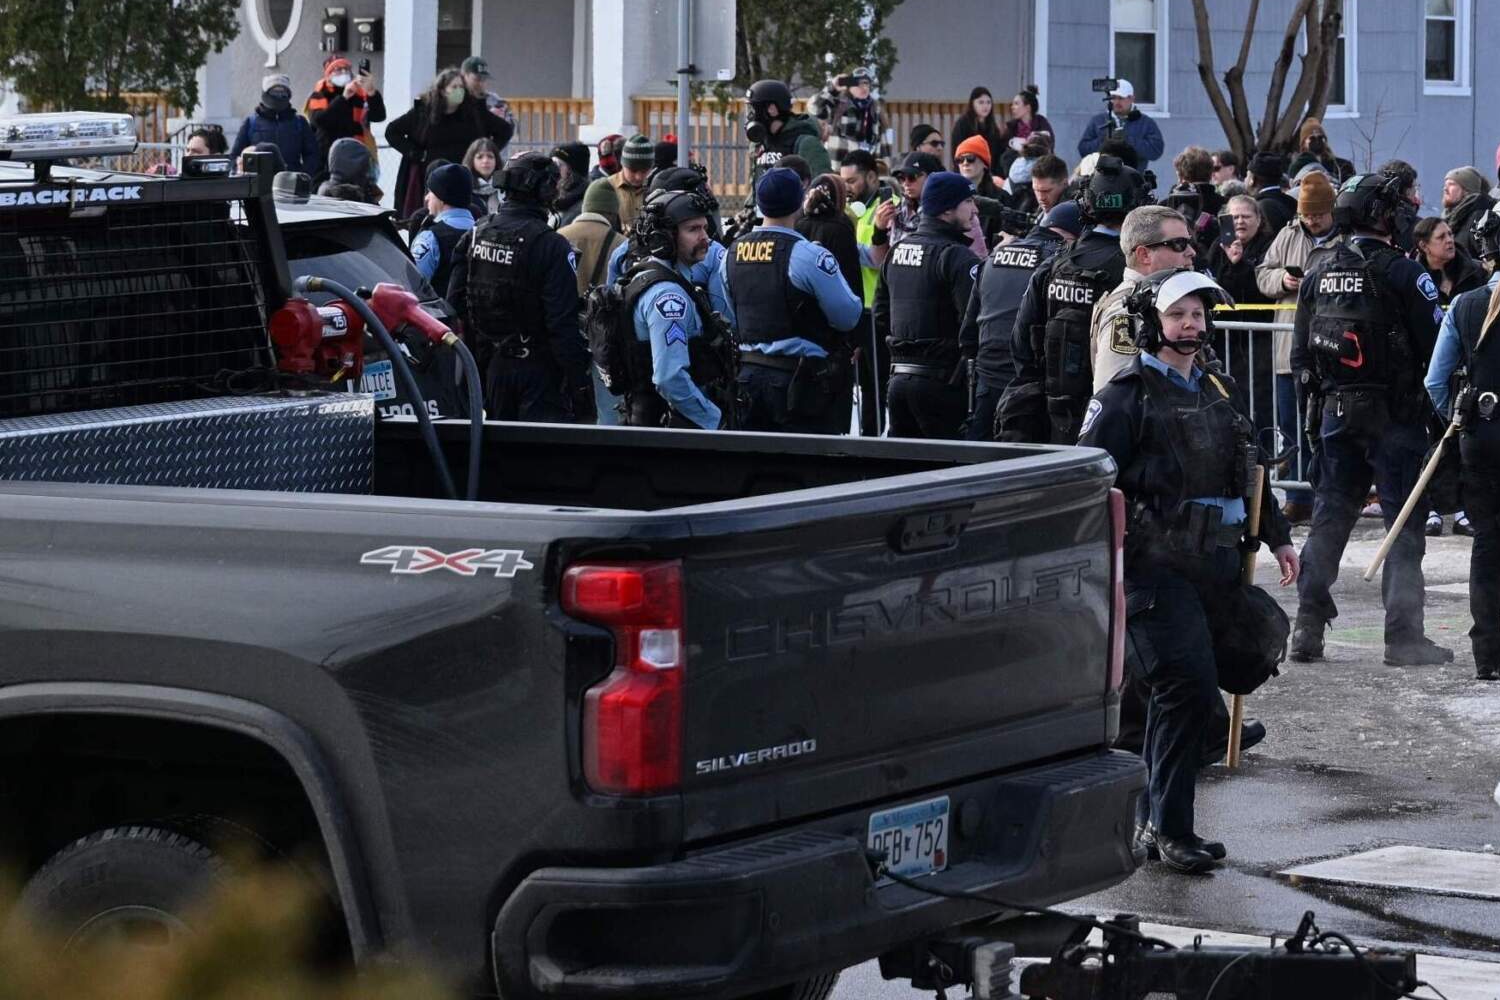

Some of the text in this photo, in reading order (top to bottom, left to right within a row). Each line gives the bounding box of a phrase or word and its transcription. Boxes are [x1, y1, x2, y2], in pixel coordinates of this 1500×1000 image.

[473, 244, 514, 264] POLICE
[736, 241, 775, 262] POLICE
[891, 248, 924, 266] POLICE
[993, 251, 1038, 267] POLICE
[1048, 283, 1094, 304] POLICE
[1319, 277, 1363, 293] POLICE
[726, 559, 1091, 662] CHEVROLET
[696, 739, 817, 775] SILVERADO
